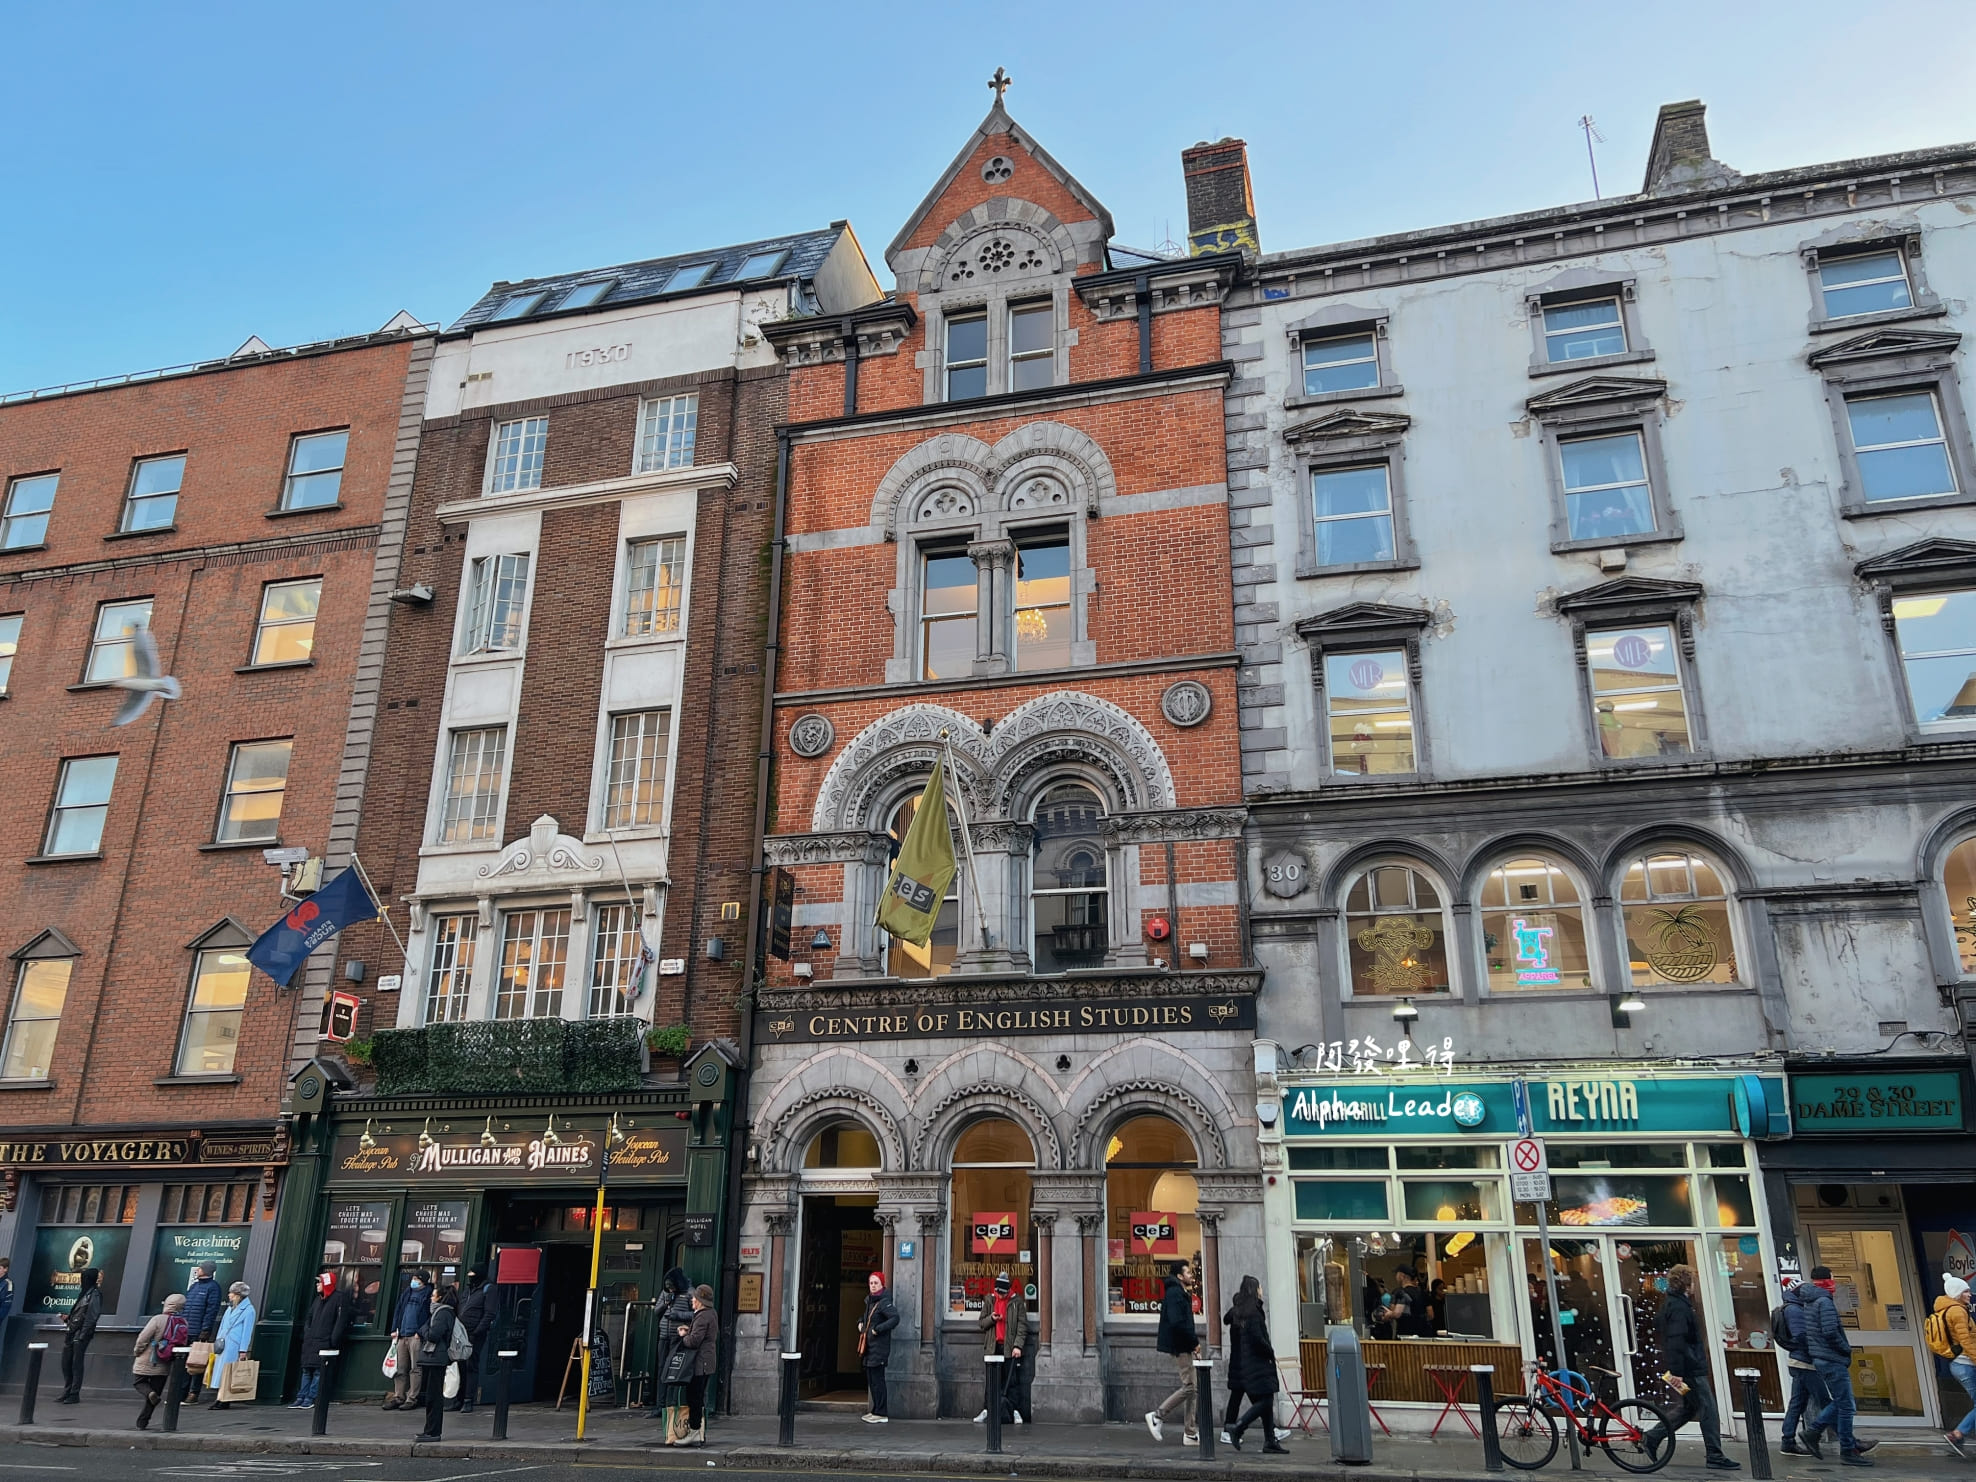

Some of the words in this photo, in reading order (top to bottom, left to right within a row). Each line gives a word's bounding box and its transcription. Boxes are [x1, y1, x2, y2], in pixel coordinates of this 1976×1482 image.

[565, 343, 632, 369] 1930
[1271, 865, 1299, 882] 30
[809, 1016, 908, 1036] CENTRE
[917, 1014, 949, 1032] OF
[957, 1010, 1071, 1030] ENGLISH
[1080, 1006, 1192, 1027] STUDIES
[1547, 1081, 1639, 1120] REYNA
[1834, 1087, 1861, 1102] 29
[1866, 1086, 1883, 1102] &
[1888, 1085, 1916, 1102] 30
[1799, 1102, 1865, 1119] DAME
[1870, 1100, 1955, 1117] STREET
[0, 1143, 47, 1162] THE
[60, 1142, 172, 1161] VOYAGER
[239, 1143, 271, 1155] SPIRITS
[620, 1136, 659, 1157] Joycean
[378, 1156, 399, 1169] Pub
[419, 1142, 501, 1172] MULLIGAN
[503, 1147, 522, 1163] AND
[527, 1140, 588, 1171] HAINES
[646, 1150, 670, 1164] Pub
[976, 1225, 1011, 1236] ces
[1134, 1225, 1171, 1236] ces
[174, 1235, 191, 1247] We
[191, 1238, 211, 1247] are
[211, 1234, 242, 1251] hiring
[955, 1263, 977, 1276] CENTRE
[1011, 1263, 1034, 1276] STUDIES
[1114, 1264, 1136, 1277] CENTRE
[1948, 1255, 1975, 1275] Boyle
[965, 1277, 1024, 1296] CEA
[1129, 1301, 1148, 1311] Test
